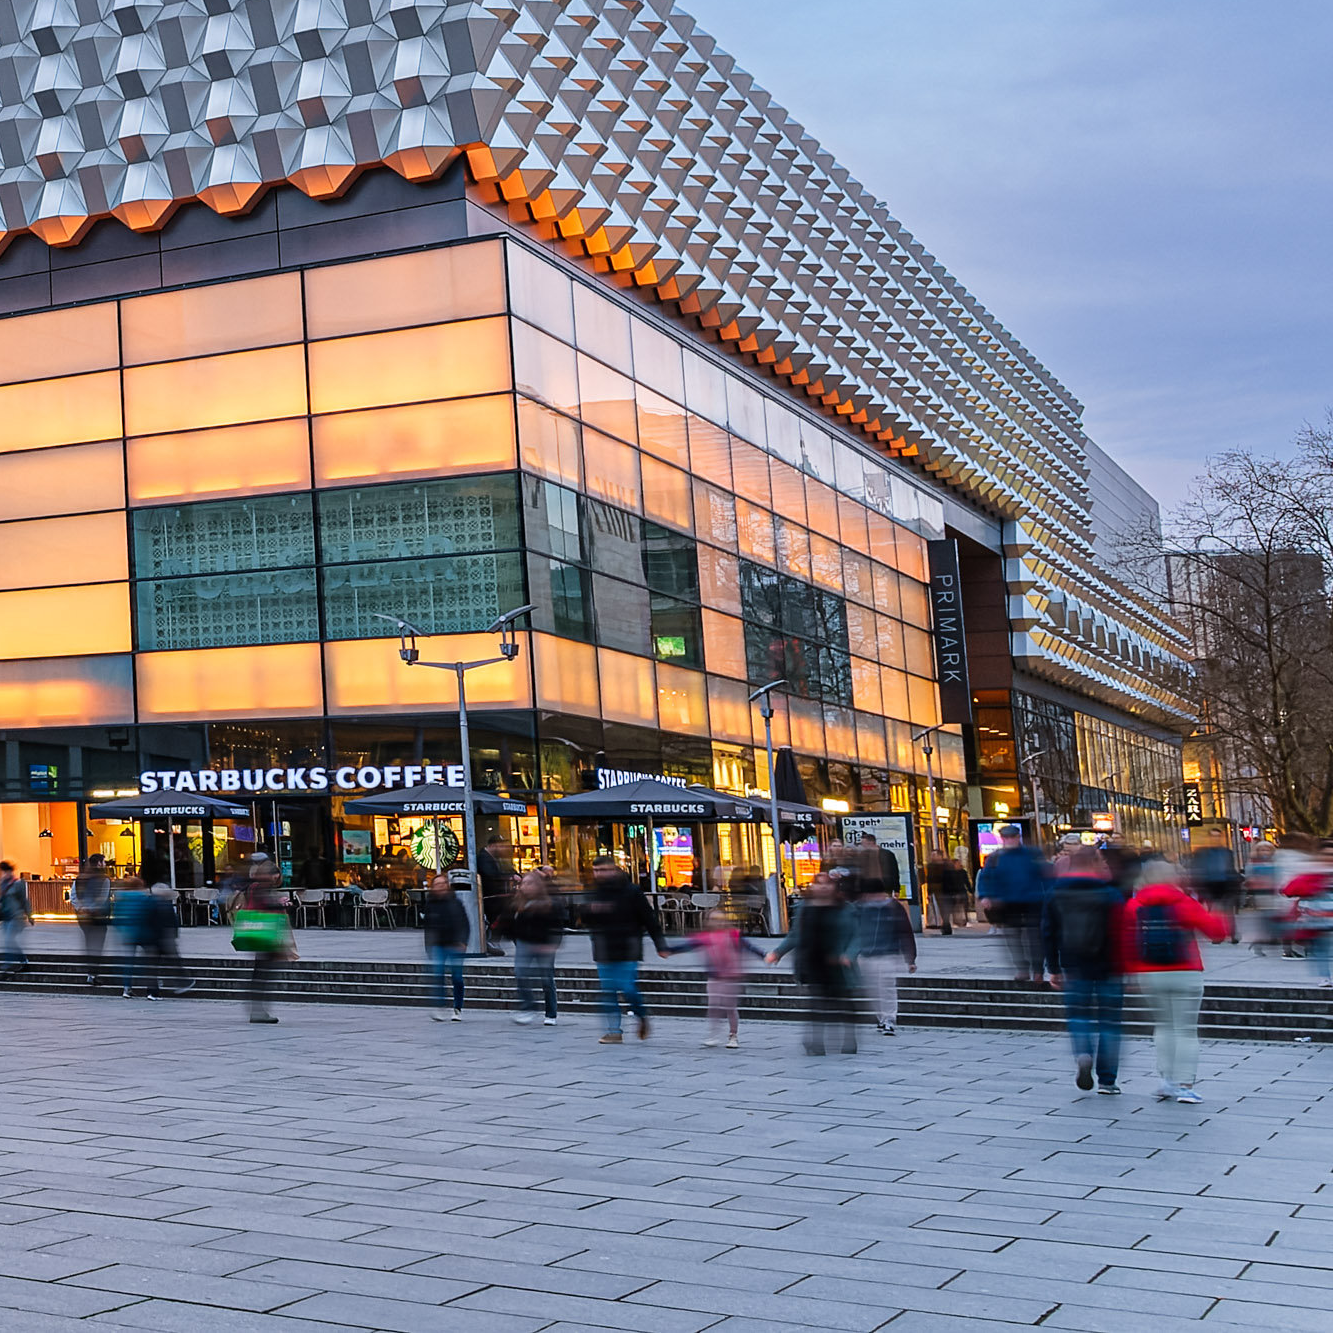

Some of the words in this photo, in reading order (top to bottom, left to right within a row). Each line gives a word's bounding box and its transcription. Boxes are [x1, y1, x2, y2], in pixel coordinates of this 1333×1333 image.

[935, 574, 962, 683] PRIMARK
[140, 766, 329, 793] STARBUCKS
[335, 764, 465, 789] COFFEE
[630, 803, 705, 814] STARBUCKS
[1186, 788, 1201, 821] ZARA
[143, 806, 205, 815] STARBUCKS
[844, 818, 857, 827] Da
[880, 840, 906, 849] mehr
